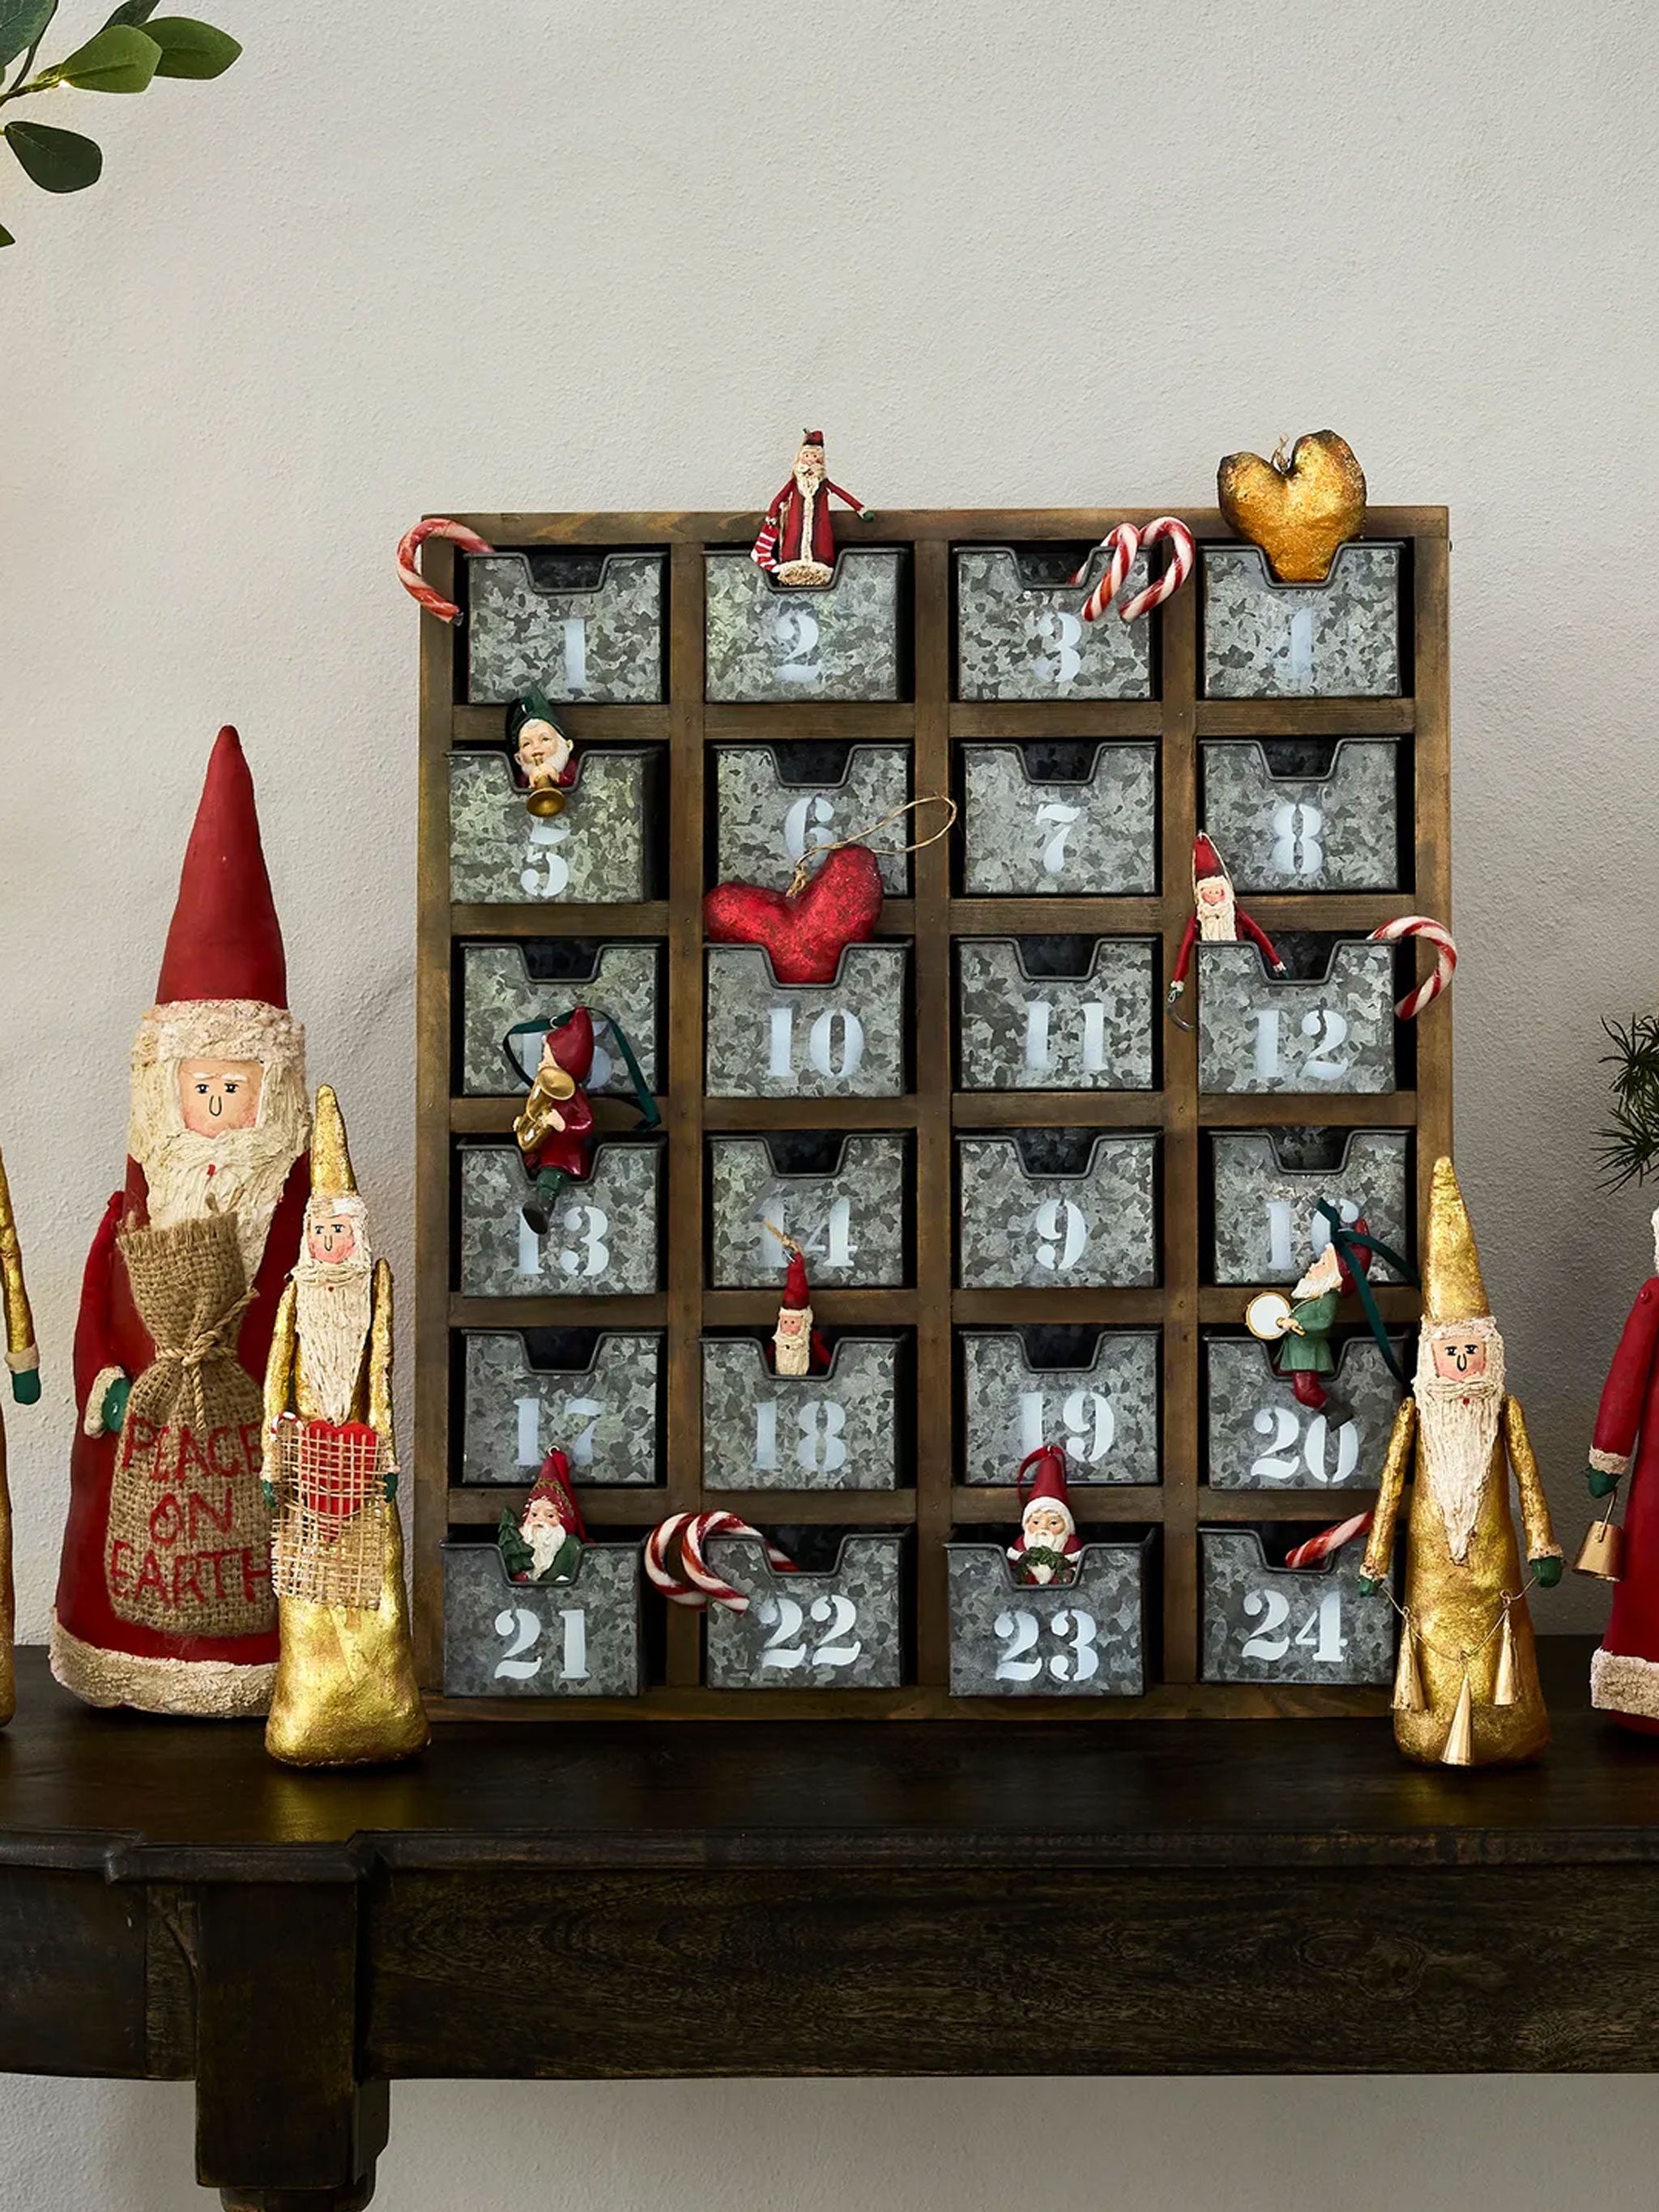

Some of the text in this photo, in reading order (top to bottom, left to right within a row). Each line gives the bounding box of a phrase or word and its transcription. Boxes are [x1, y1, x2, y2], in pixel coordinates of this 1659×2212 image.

[561, 618, 589, 692] 1
[774, 614, 821, 684] 2
[1032, 611, 1082, 682] 3
[520, 820, 571, 897] 5
[784, 797, 835, 867] 6
[1035, 803, 1081, 874] 7
[1273, 803, 1324, 875] 8
[766, 1007, 865, 1080] 10
[1024, 1000, 1107, 1072] 11
[1252, 1008, 1350, 1080] 12
[516, 1205, 611, 1276] 13
[757, 1196, 859, 1269] 14
[1034, 1198, 1089, 1272] 9
[122, 1412, 261, 1483] PEACE
[514, 1396, 602, 1467] 17
[754, 1400, 848, 1473] 18
[1018, 1391, 1117, 1464] 19
[1251, 1406, 1361, 1483] 20
[149, 1485, 233, 1549] ON
[494, 1608, 591, 1681] 21
[759, 1595, 862, 1669] 22
[993, 1609, 1099, 1682] 23
[1241, 1589, 1349, 1663] 24
